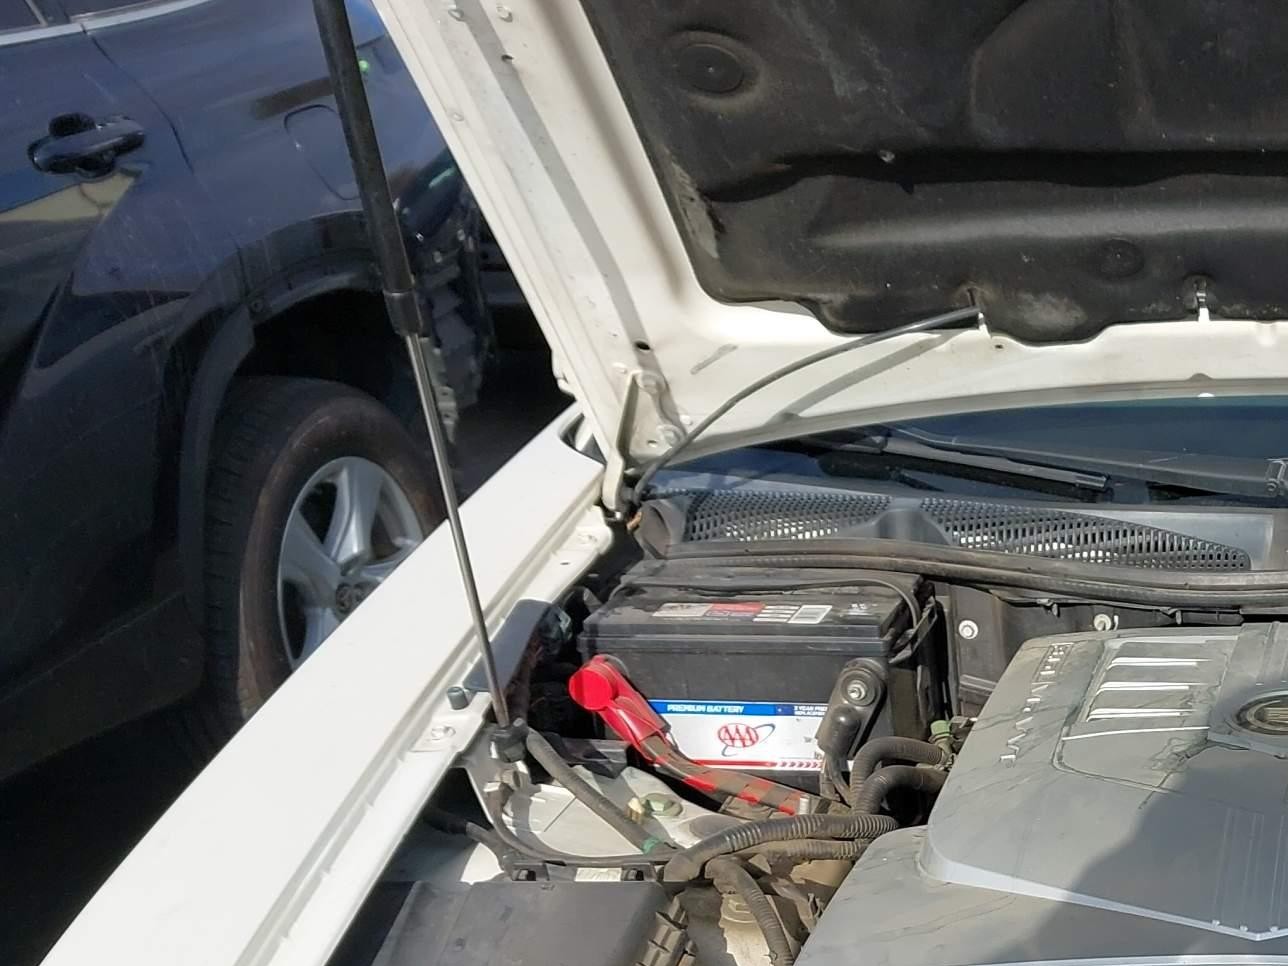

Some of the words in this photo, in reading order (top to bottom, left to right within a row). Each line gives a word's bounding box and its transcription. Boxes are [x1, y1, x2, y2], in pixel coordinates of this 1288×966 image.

[667, 704, 706, 713] PREMIUM
[707, 704, 745, 714] BATTERY
[719, 724, 758, 748] AAA
